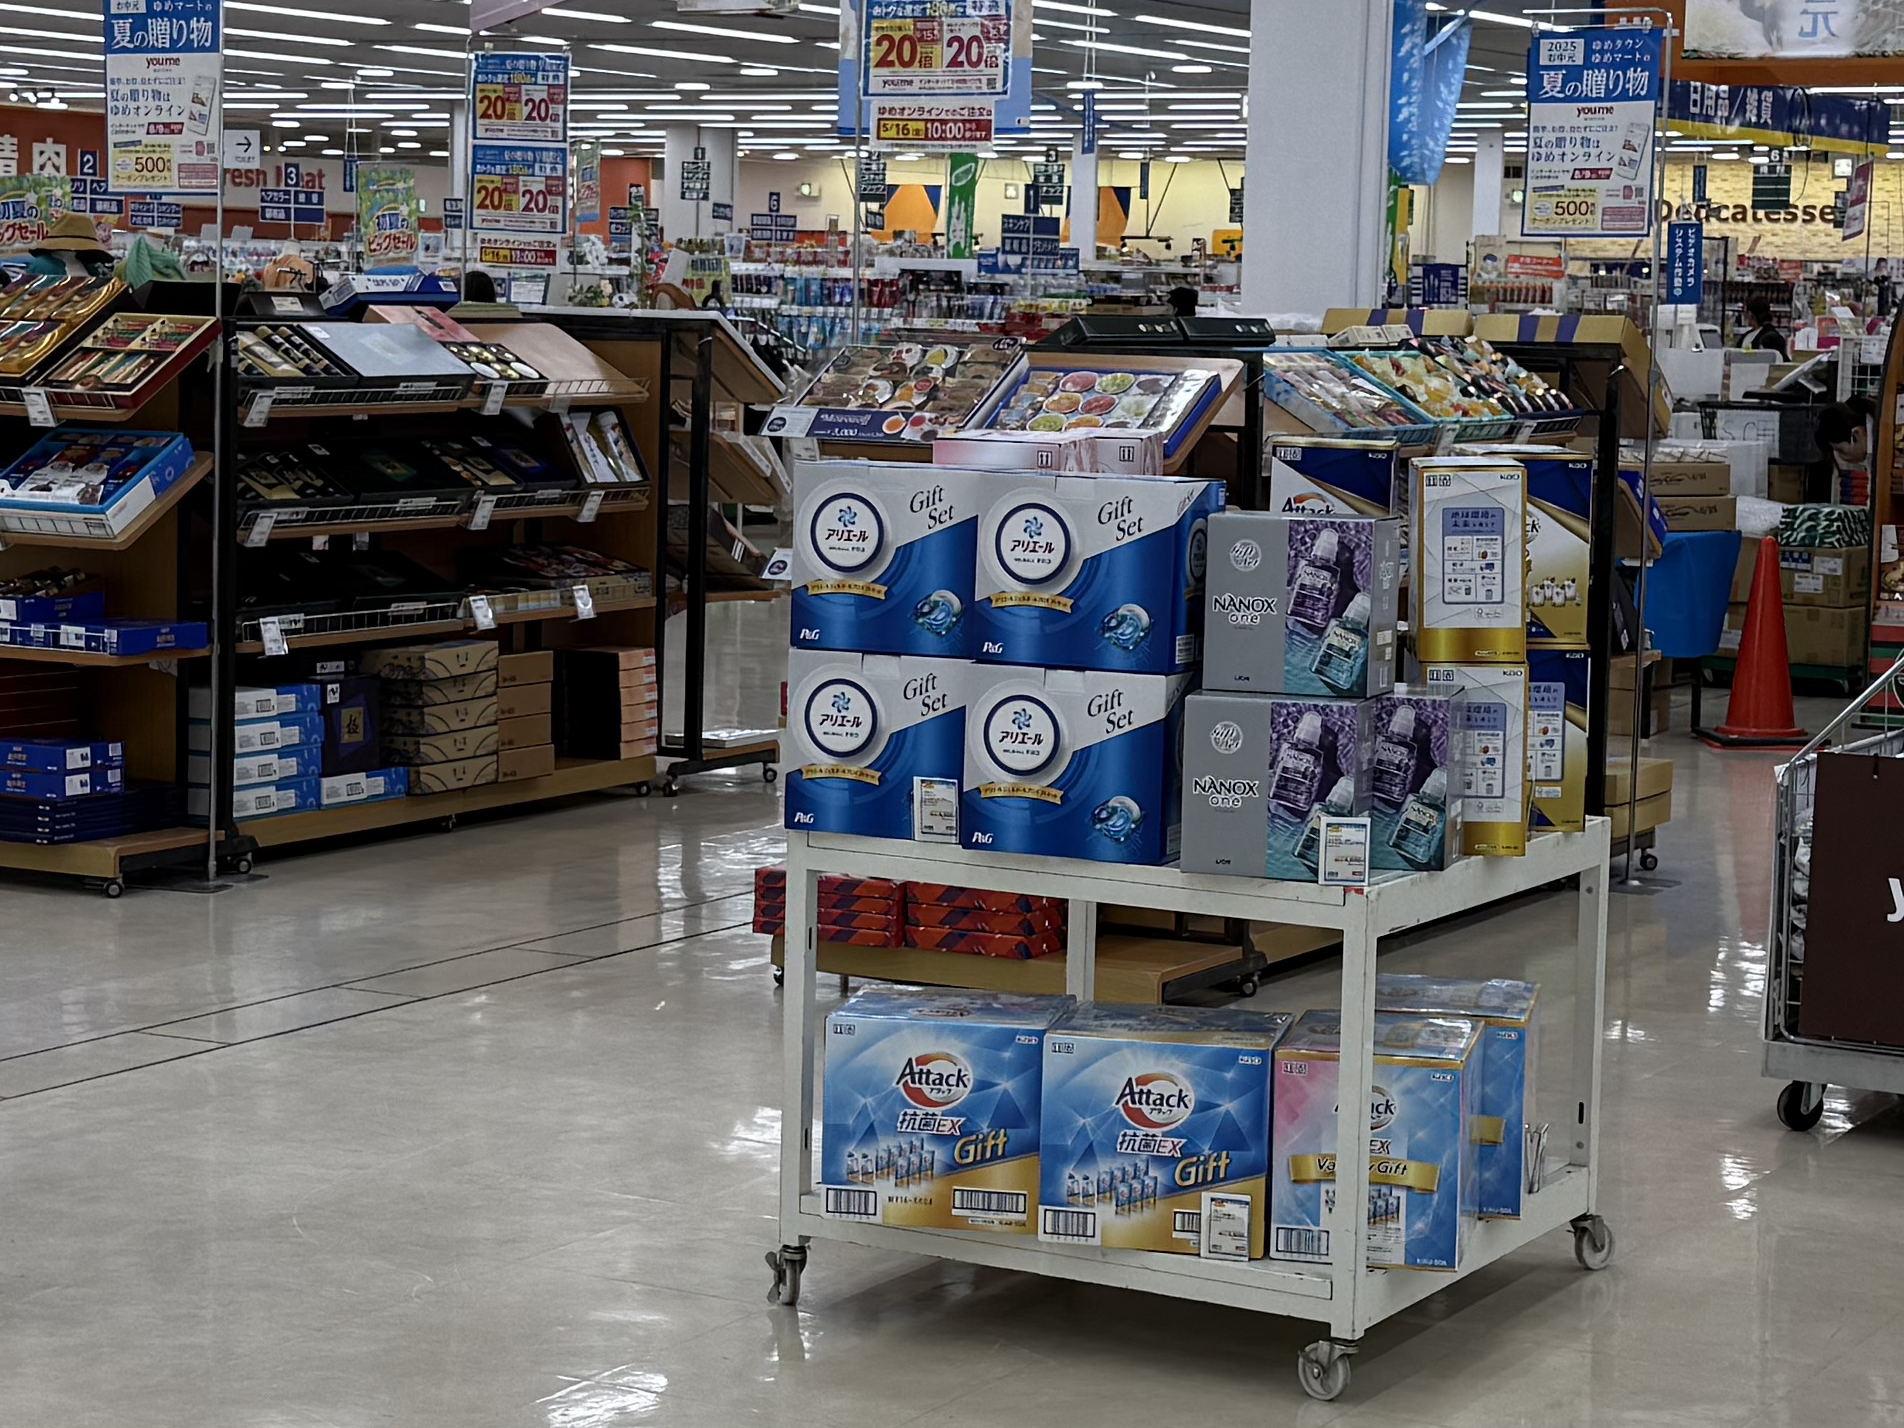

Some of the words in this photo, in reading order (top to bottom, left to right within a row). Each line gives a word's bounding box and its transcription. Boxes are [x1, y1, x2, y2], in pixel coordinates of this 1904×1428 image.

[153, 0, 212, 12] ゆめマートの
[112, 17, 212, 49] 夏の贈り物
[1592, 39, 1643, 50] ゆめタウン
[873, 34, 918, 68] 20
[946, 35, 984, 68] 20
[1548, 41, 1577, 52] 2025
[1591, 52, 1650, 63] ゆめマートの
[1539, 68, 1649, 98] 夏の贈り物
[110, 89, 171, 103] 夏の贈り物は
[110, 105, 185, 117] ゆめオンライン
[927, 122, 964, 139] 10:00
[1532, 136, 1600, 149] 夏の贈り物は
[83, 154, 94, 173] 2
[134, 157, 165, 172] 500
[1531, 152, 1615, 163] ゆめオンライン
[287, 167, 296, 184] 3
[476, 185, 503, 210] 20
[521, 189, 548, 213] 20
[1554, 201, 1589, 216] 500
[909, 485, 944, 514] Gift
[1097, 495, 1134, 526] Gift
[927, 504, 955, 530] Set
[826, 529, 869, 543] アリエール
[1115, 516, 1144, 542] Set
[1011, 540, 1055, 554] アリエール
[1213, 593, 1277, 616] NANOX
[1228, 610, 1260, 625] one
[902, 673, 938, 701] Gift
[921, 692, 948, 717] Set
[1087, 688, 1124, 719] Gift
[819, 714, 862, 728] アリエール
[1105, 708, 1134, 734] Set
[999, 731, 1044, 746] アリエール
[1194, 777, 1259, 799] NANOX
[1209, 793, 1241, 808] one
[896, 1056, 970, 1089] Attack
[1114, 1076, 1190, 1108] Attack
[897, 1109, 965, 1136] 抗菌EX
[954, 1128, 1009, 1165] Gift
[1117, 1130, 1187, 1158] 抗菌EX
[1174, 1150, 1231, 1187] Gift
